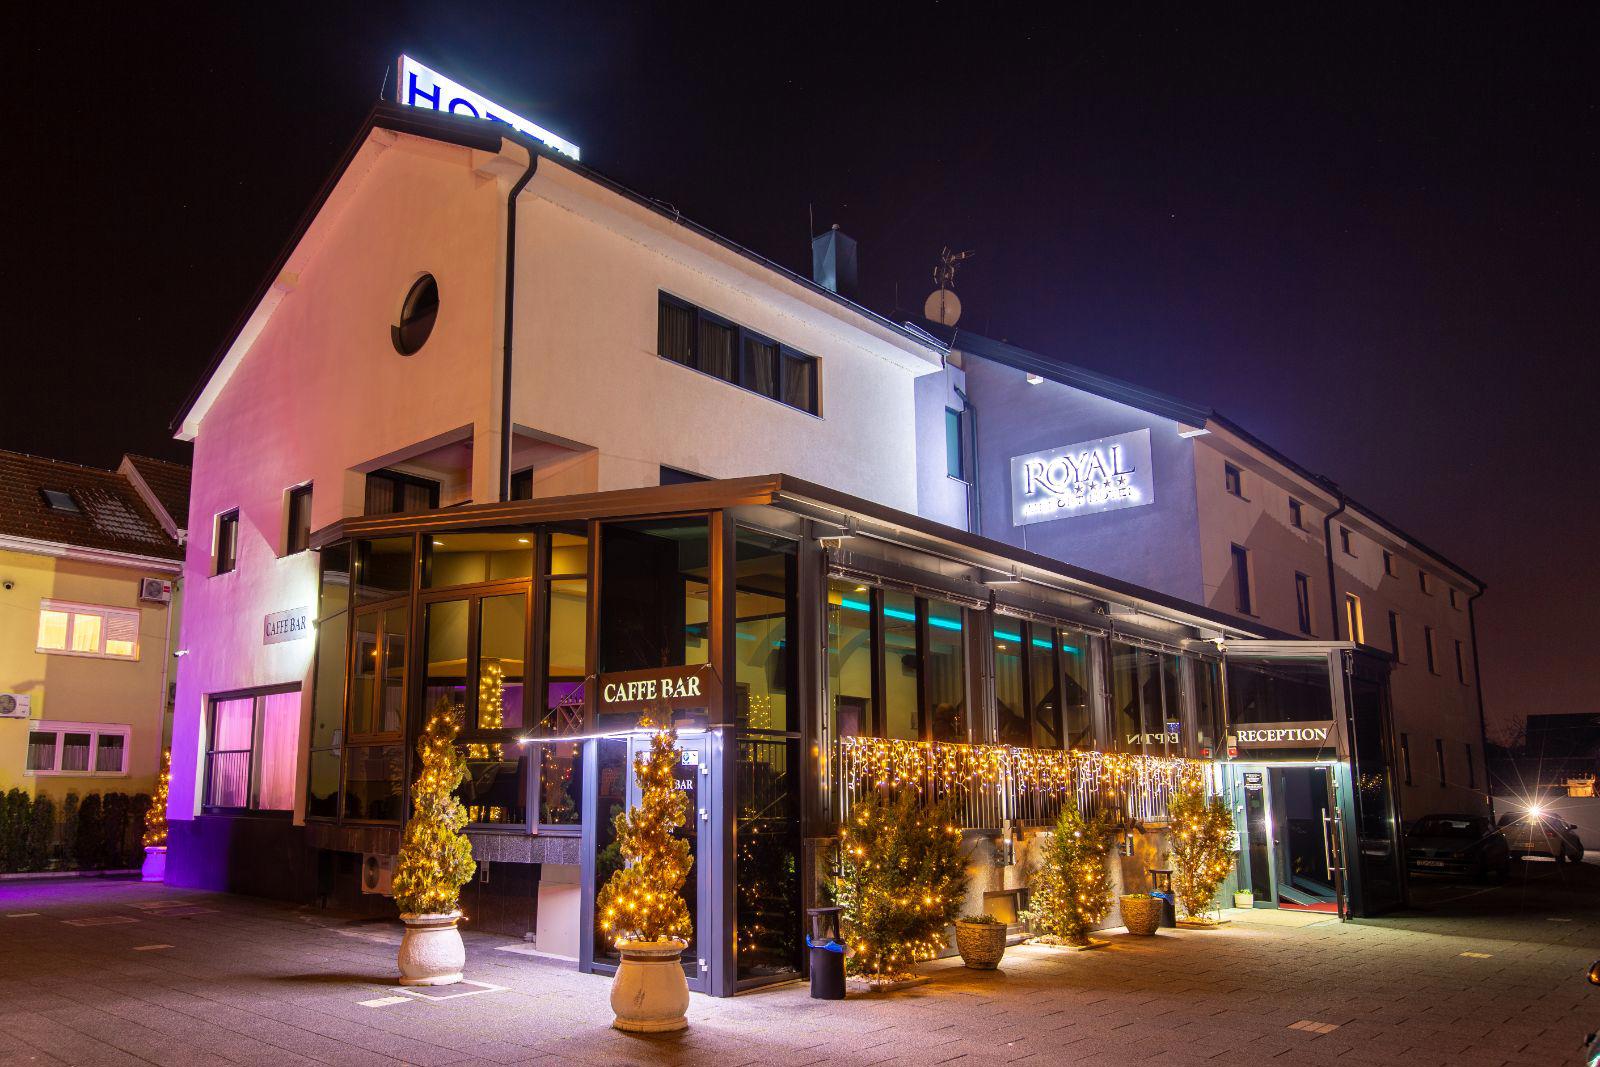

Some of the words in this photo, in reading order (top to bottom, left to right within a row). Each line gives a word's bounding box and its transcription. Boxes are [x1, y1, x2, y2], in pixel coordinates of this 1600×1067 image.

[1024, 445, 1137, 495] ROYAL
[266, 619, 288, 637] CAFFE
[290, 615, 306, 632] BAR
[604, 679, 657, 703] CAFFE
[661, 676, 701, 699] BAR
[1236, 728, 1328, 742] RECEPTION
[674, 779, 694, 790] BAR
